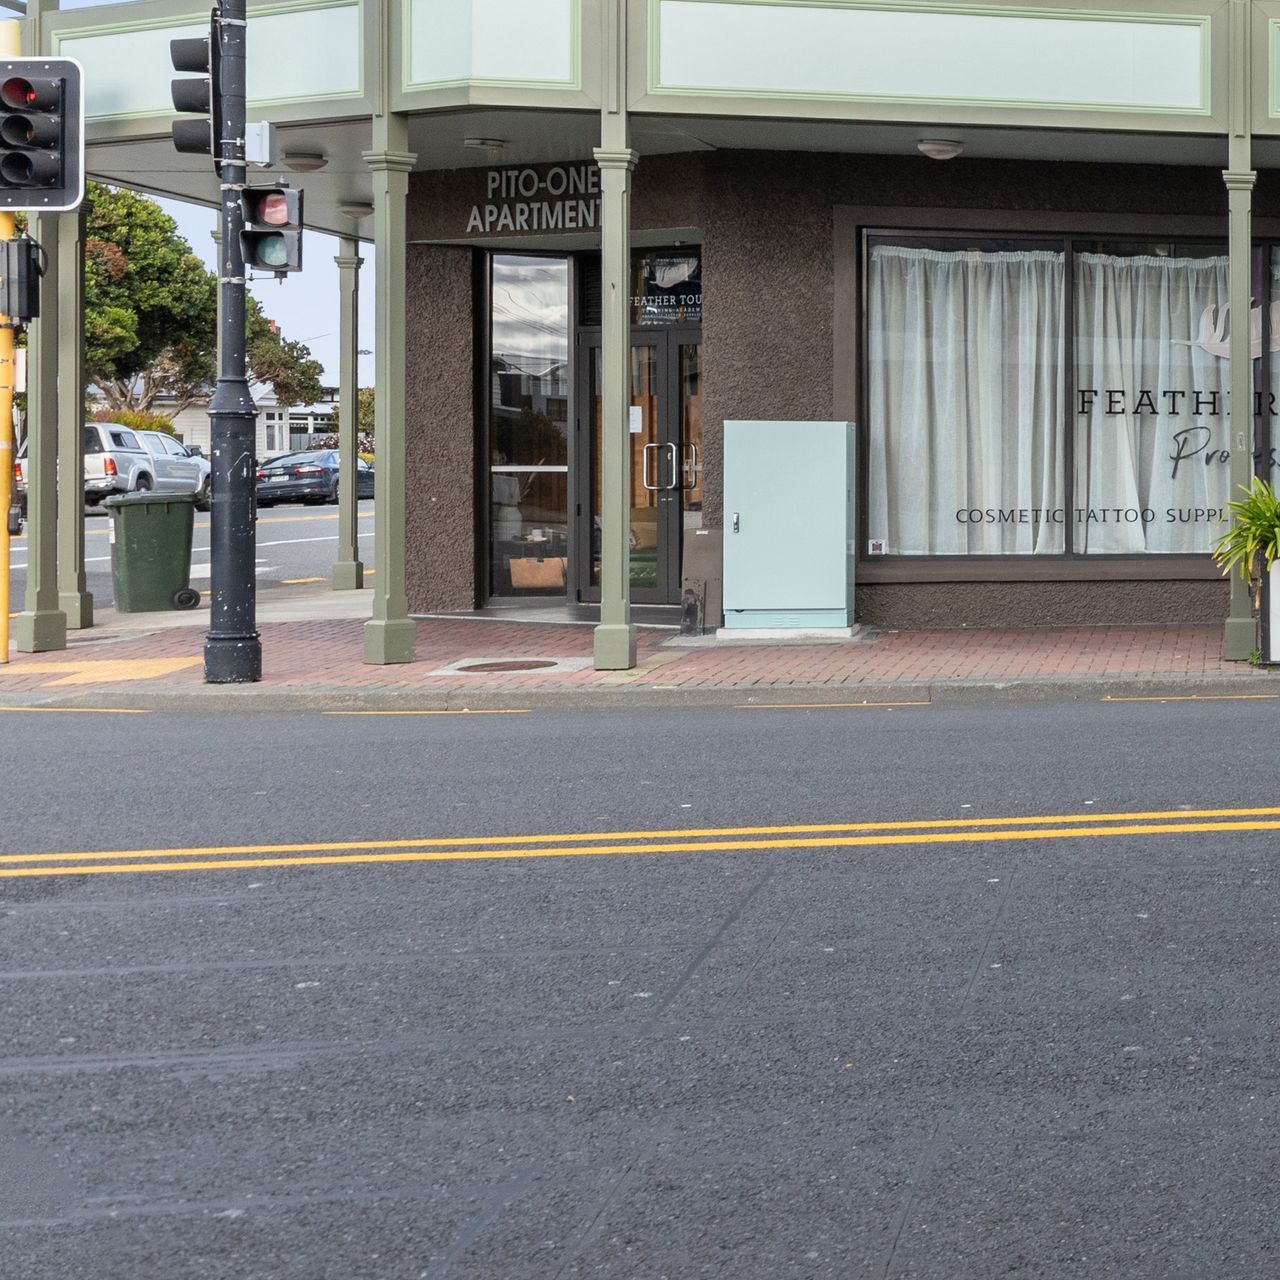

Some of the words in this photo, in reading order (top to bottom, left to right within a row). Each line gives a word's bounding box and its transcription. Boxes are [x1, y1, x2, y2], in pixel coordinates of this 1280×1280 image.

[487, 165, 599, 199] PITO-ONE
[466, 199, 603, 233] APARTMENT
[680, 293, 702, 305] TOU
[1077, 389, 1279, 416] FEATHR
[955, 508, 1065, 523] COSMETIC
[1074, 508, 1156, 523] TATTOO
